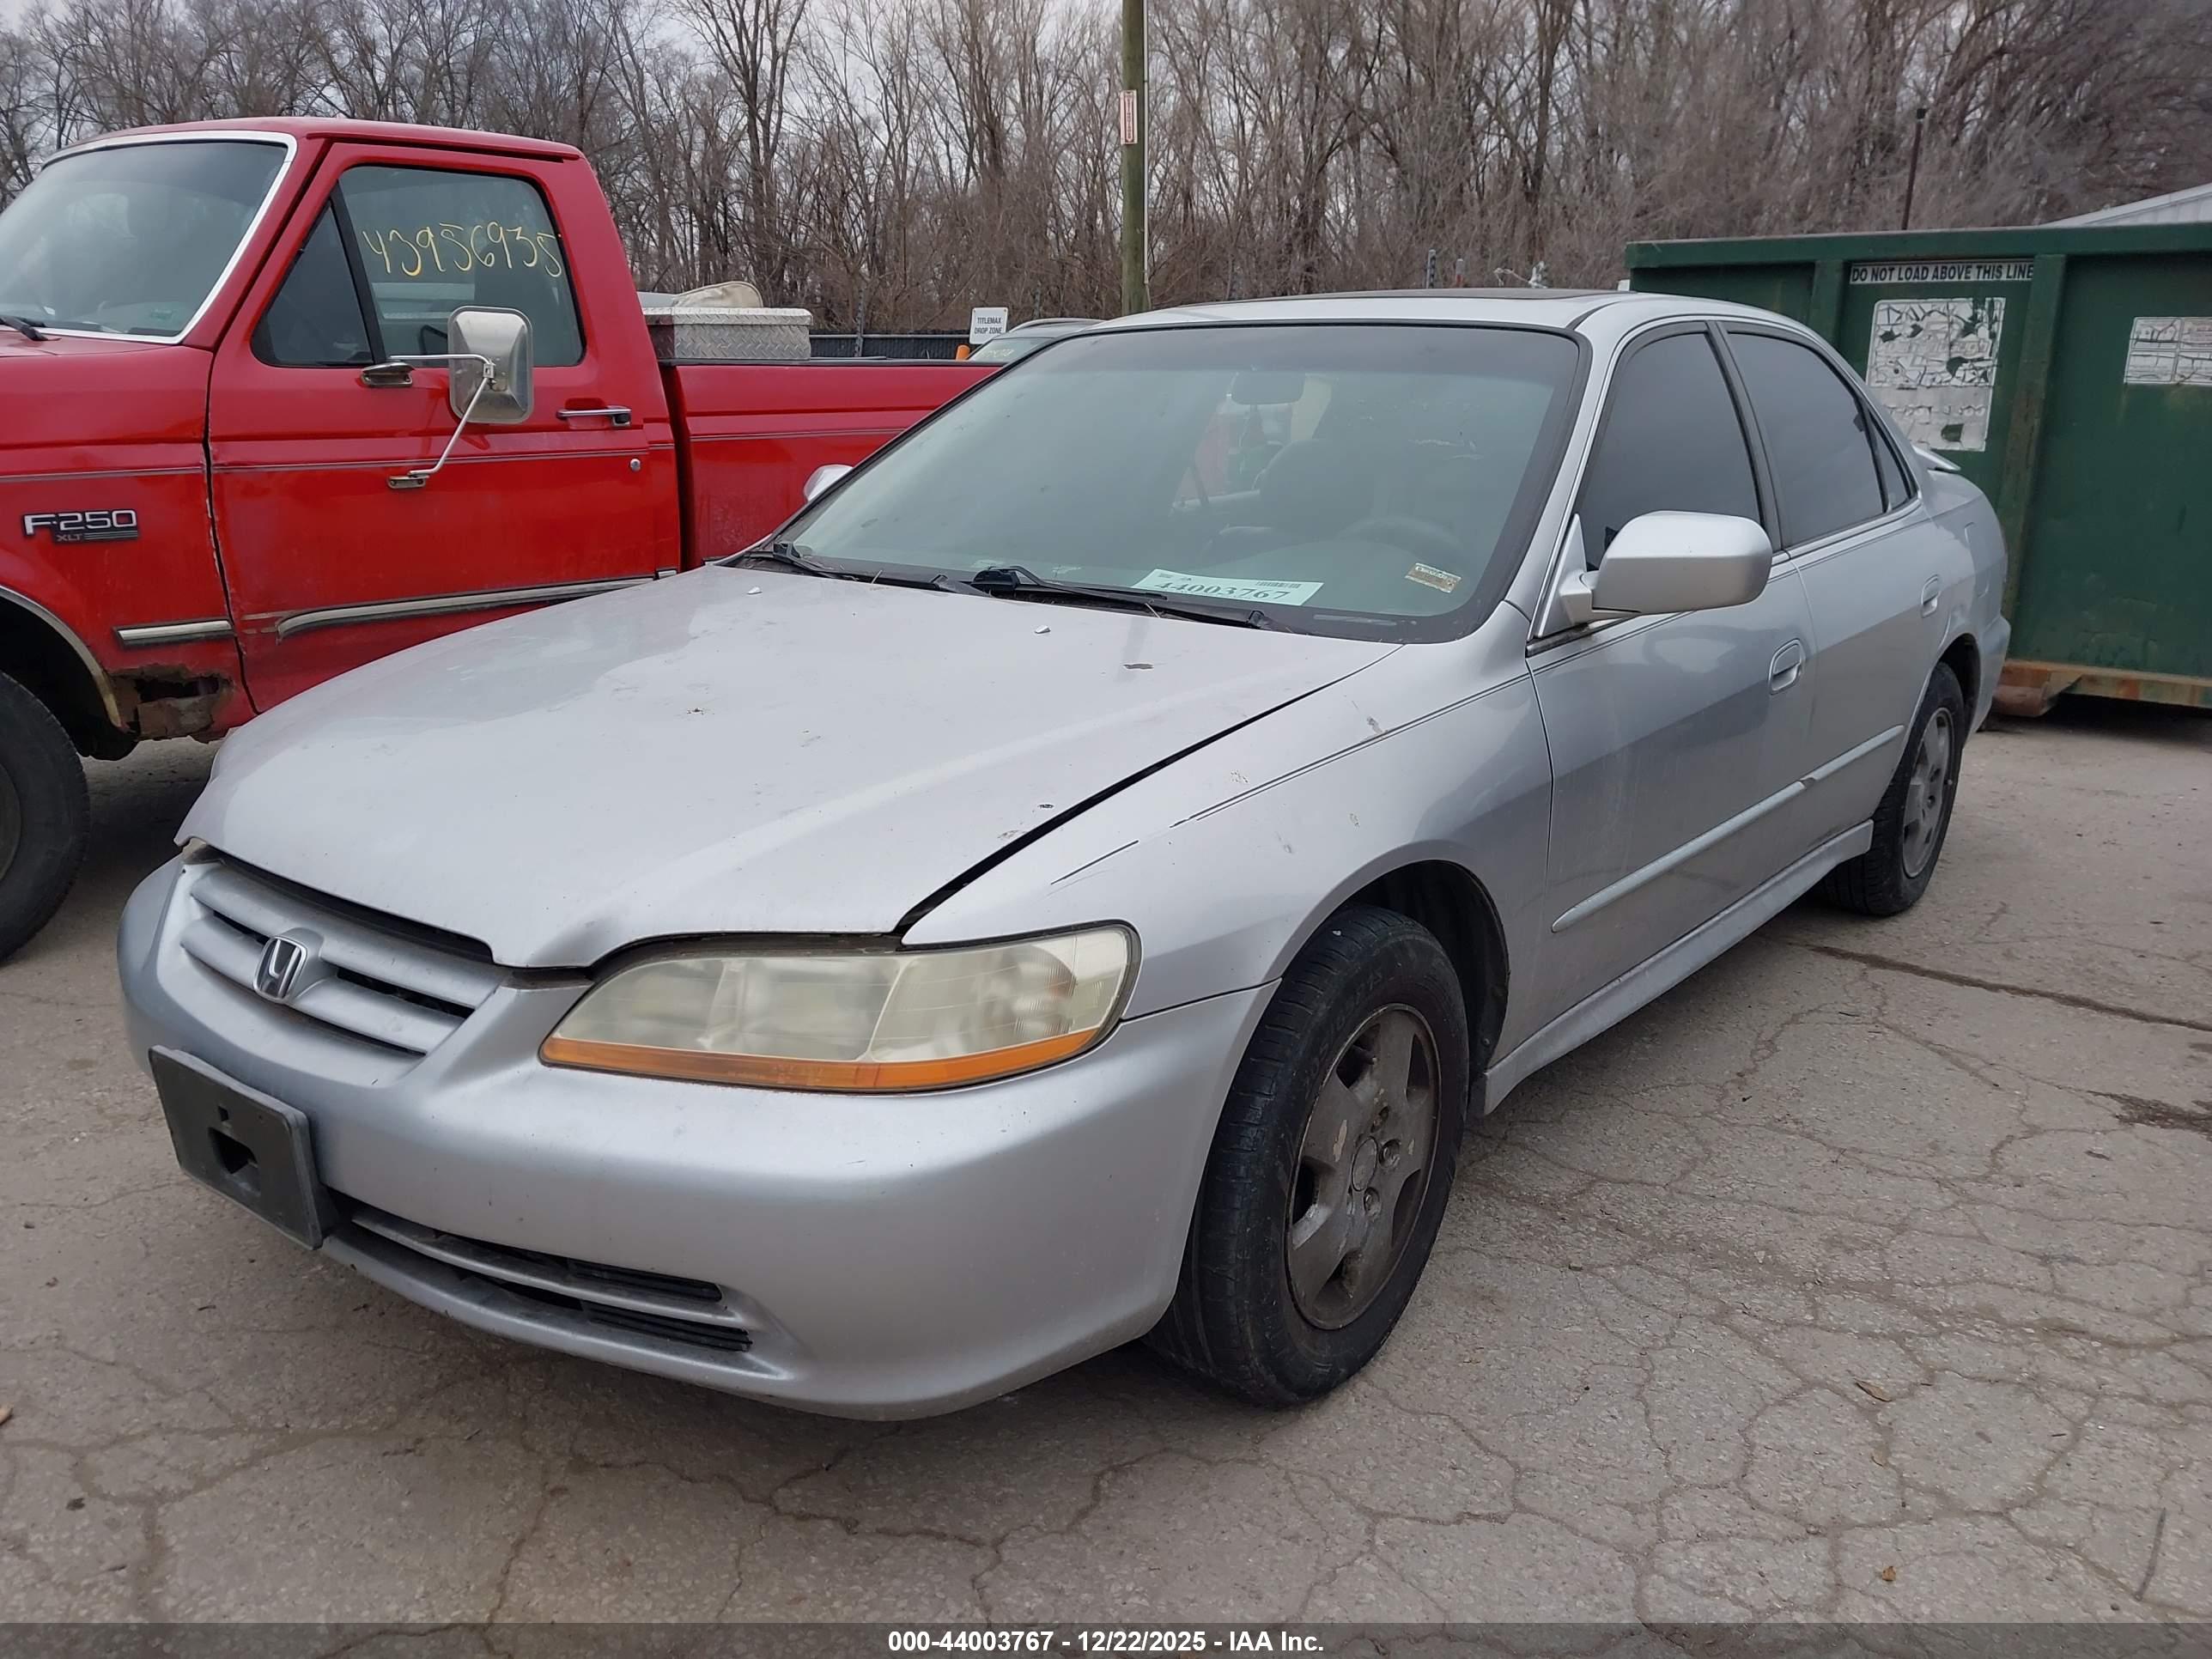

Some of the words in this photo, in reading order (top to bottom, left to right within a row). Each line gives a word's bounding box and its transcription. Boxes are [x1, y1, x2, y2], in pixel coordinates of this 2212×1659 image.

[362, 221, 562, 277] 43956935
[1851, 267, 1869, 283] DO
[1870, 266, 1895, 282] NOT
[1898, 265, 1929, 282] LOAD
[1931, 264, 1973, 281] ABOVE
[1975, 264, 2003, 280] THIS
[2005, 264, 2033, 280] LINE
[57, 533, 83, 542] XLT
[1154, 581, 1291, 600] 44003767
